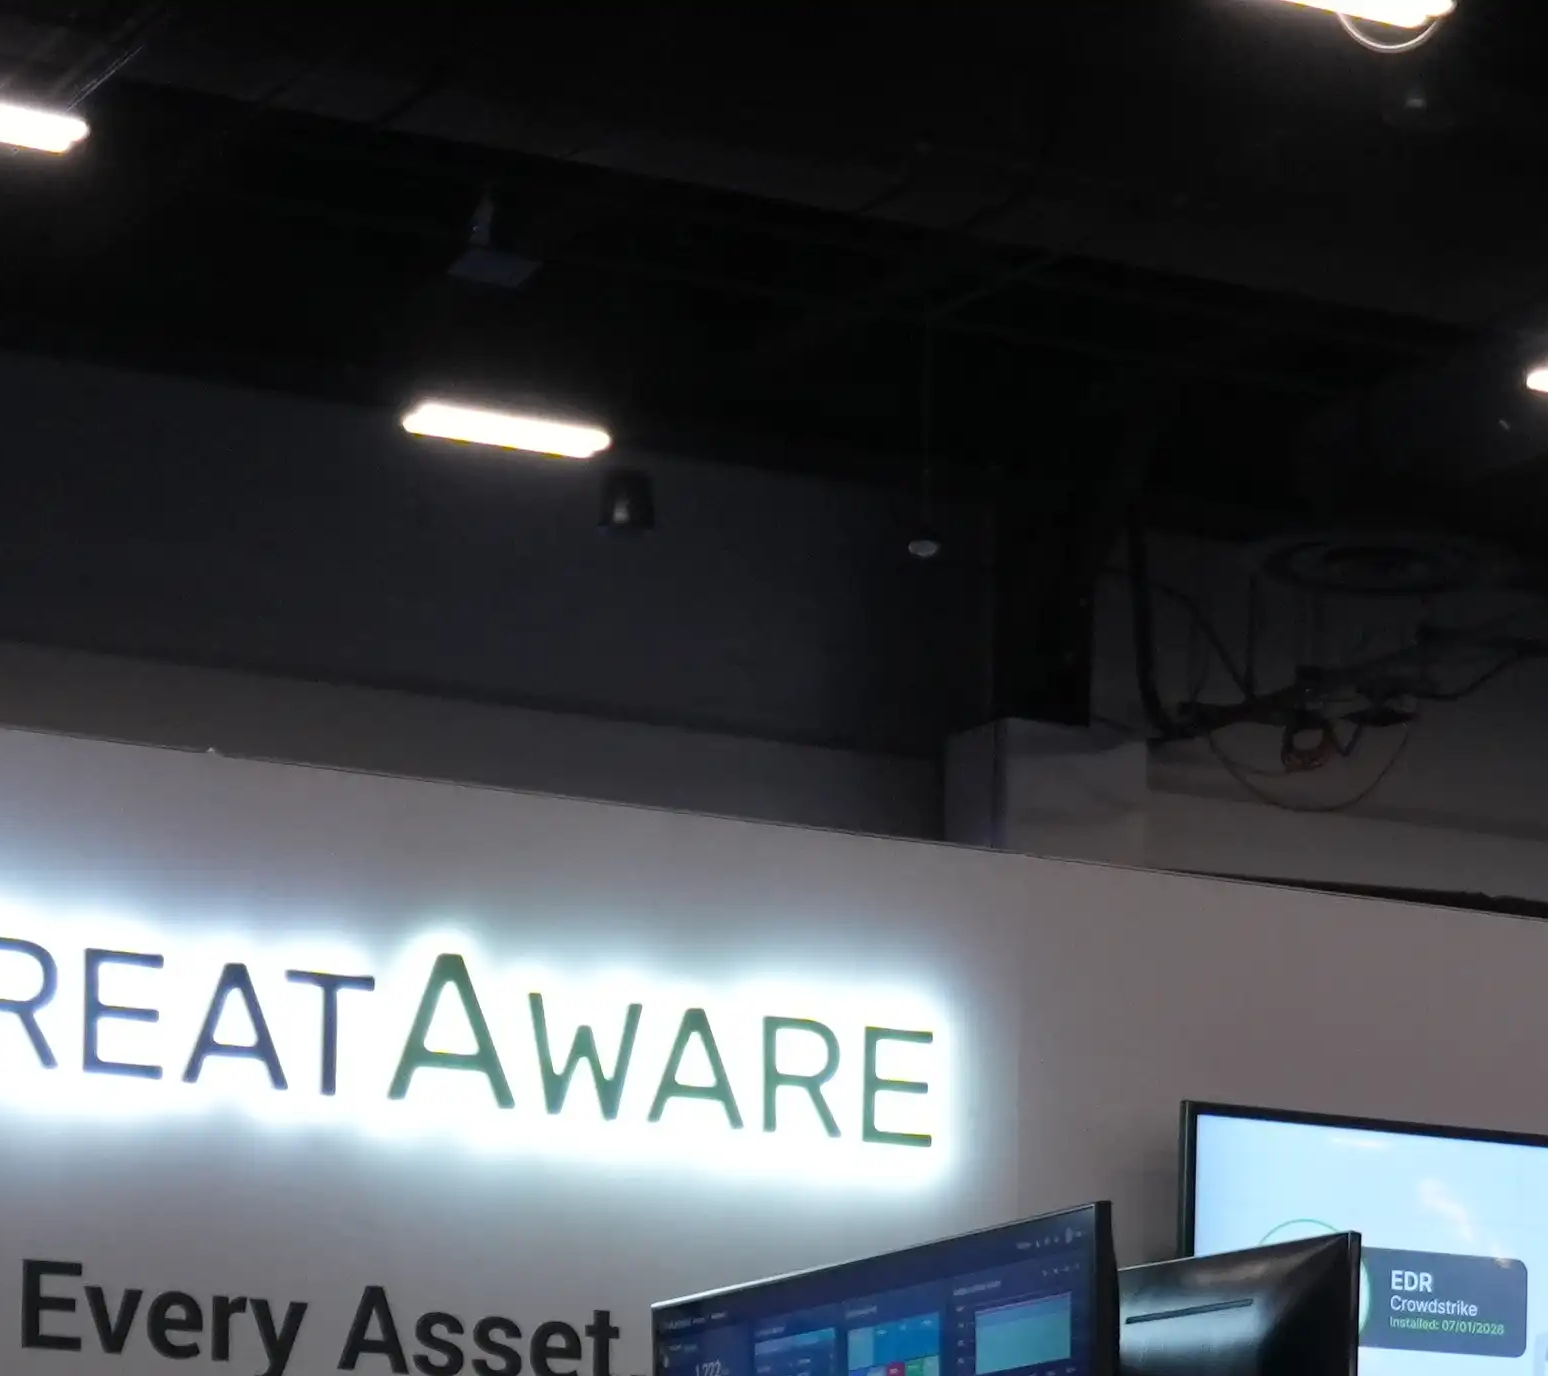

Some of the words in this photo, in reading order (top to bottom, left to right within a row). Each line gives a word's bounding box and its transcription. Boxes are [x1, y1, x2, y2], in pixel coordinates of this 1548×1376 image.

[1390, 1270, 1433, 1293] EDR
[1390, 1295, 1478, 1317] Crowdstrike
[1389, 1316, 1439, 1331] Installed:
